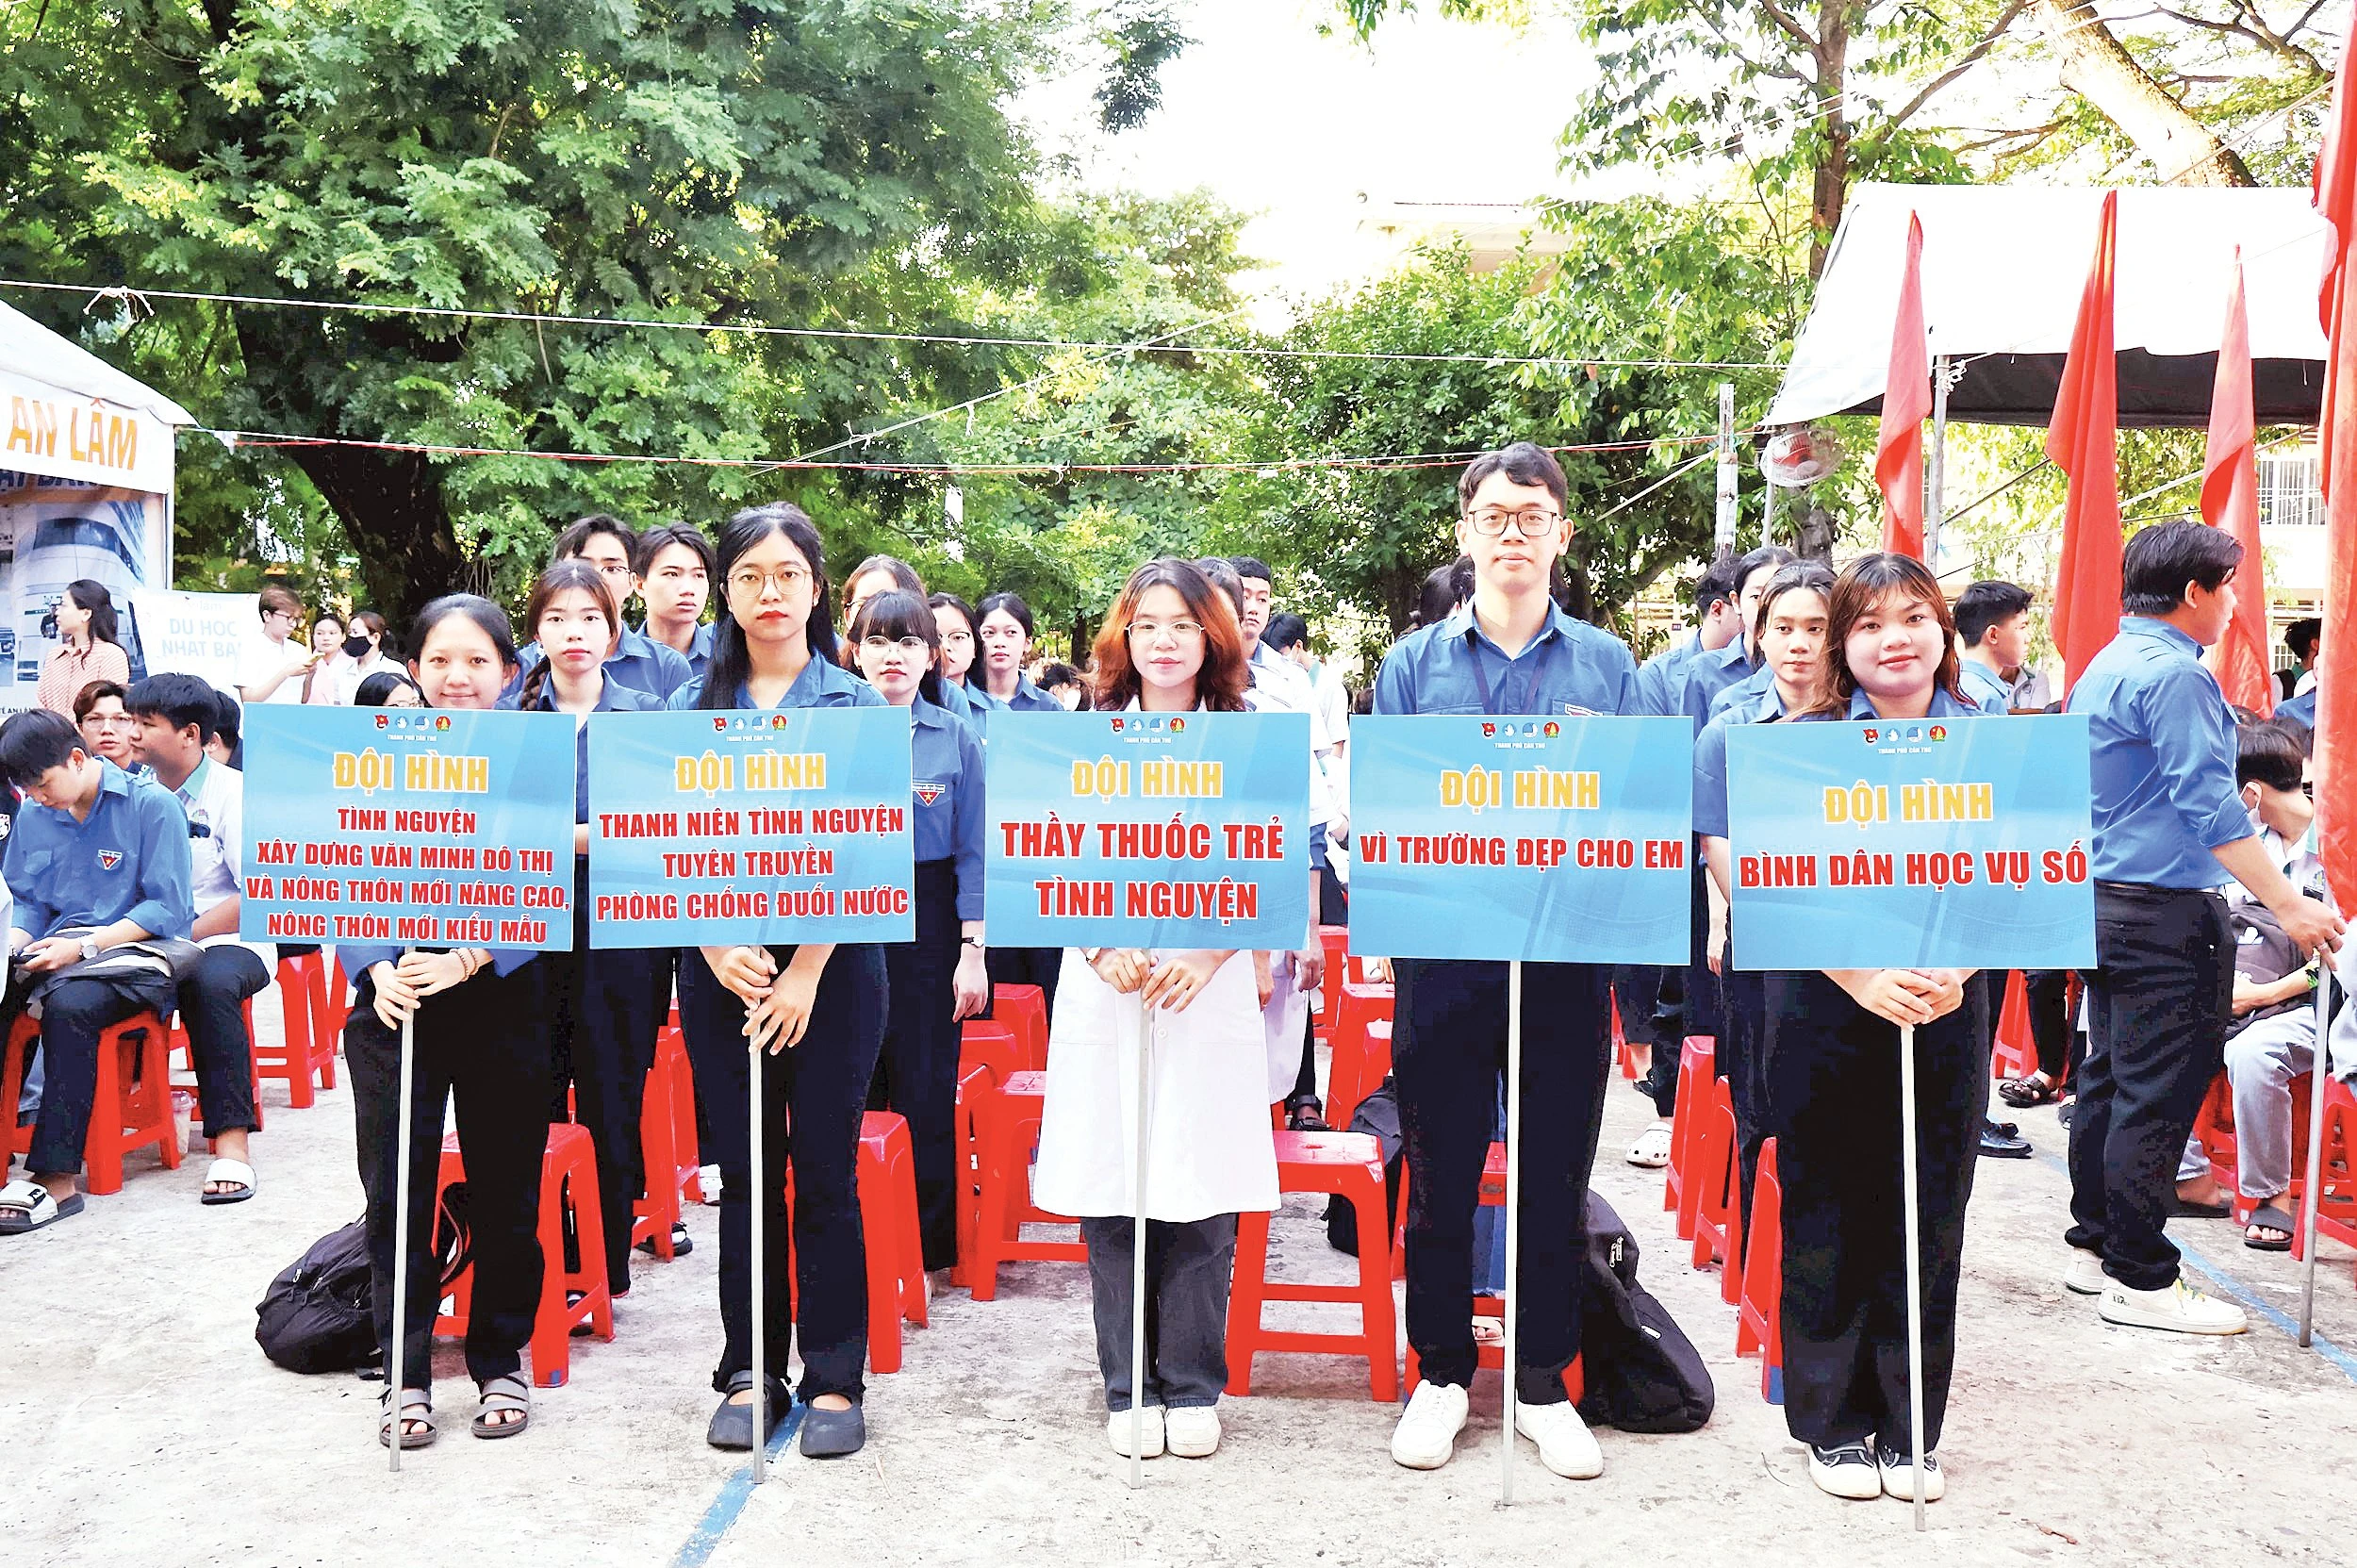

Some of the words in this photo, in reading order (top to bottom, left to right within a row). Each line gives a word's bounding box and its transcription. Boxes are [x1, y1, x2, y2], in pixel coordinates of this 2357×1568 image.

[7, 397, 58, 457] AN
[70, 398, 138, 470] LÂM
[169, 618, 193, 635] DU
[334, 748, 392, 795] ĐỘI
[405, 751, 488, 792] HÌNH
[676, 751, 733, 797] ĐỘI
[746, 750, 825, 789] HÌNH
[1072, 755, 1129, 801] ĐỘI
[1142, 756, 1222, 798] HÌNH
[1441, 766, 1501, 814] ĐỘI
[1513, 767, 1599, 808] HÌNH
[338, 806, 387, 831] TÌNH
[395, 808, 476, 836] NGUYỆN
[599, 813, 678, 838] THANH
[686, 808, 739, 836] NIÊN
[749, 807, 803, 835] TÌNH
[812, 804, 903, 837] NGUYỆN
[1823, 780, 1887, 829] ĐỘI
[1901, 779, 1993, 821] HÌNH
[1000, 812, 1085, 857] THẦY
[1096, 812, 1211, 859] THUỐC
[1223, 816, 1283, 859] TRẺ
[1360, 832, 1387, 863] VÌ
[1396, 833, 1506, 866] TRƯỜNG
[1516, 838, 1567, 871] ĐẸP
[1577, 838, 1634, 868] CHO
[1645, 840, 1683, 868] EM
[257, 839, 297, 865] XÂY
[305, 842, 363, 872] DỰNG
[371, 841, 412, 867] VĂN
[420, 847, 475, 869] MINH
[483, 849, 511, 871] ĐÔ
[519, 850, 552, 875] THỊ
[662, 849, 735, 878] TUYÊN
[744, 842, 833, 876] TRUYỀN
[1739, 850, 1817, 887] BÌNH
[1829, 850, 1893, 886] DÂN
[1906, 851, 1973, 891] HỌC
[1985, 851, 2030, 889] VỤ
[2042, 840, 2086, 883] SỐ
[246, 875, 274, 900] VÀ
[282, 876, 339, 901] NÔNG
[348, 877, 403, 903] THÔN
[411, 880, 452, 904] MỚI
[459, 881, 515, 906] NÂNG
[523, 885, 569, 911] CAO,
[597, 887, 678, 920] PHÒNG
[686, 885, 768, 919] CHỐNG
[777, 883, 834, 916] ĐUỐI
[844, 885, 908, 915] NƯỚC
[1036, 876, 1113, 916] TÌNH
[1127, 878, 1257, 925] NGUYỆN
[268, 912, 326, 937] NÔNG
[335, 913, 389, 938] THÔN
[398, 915, 438, 940] MỚI
[446, 913, 493, 942] KIỂU
[501, 915, 547, 943] MẪU
